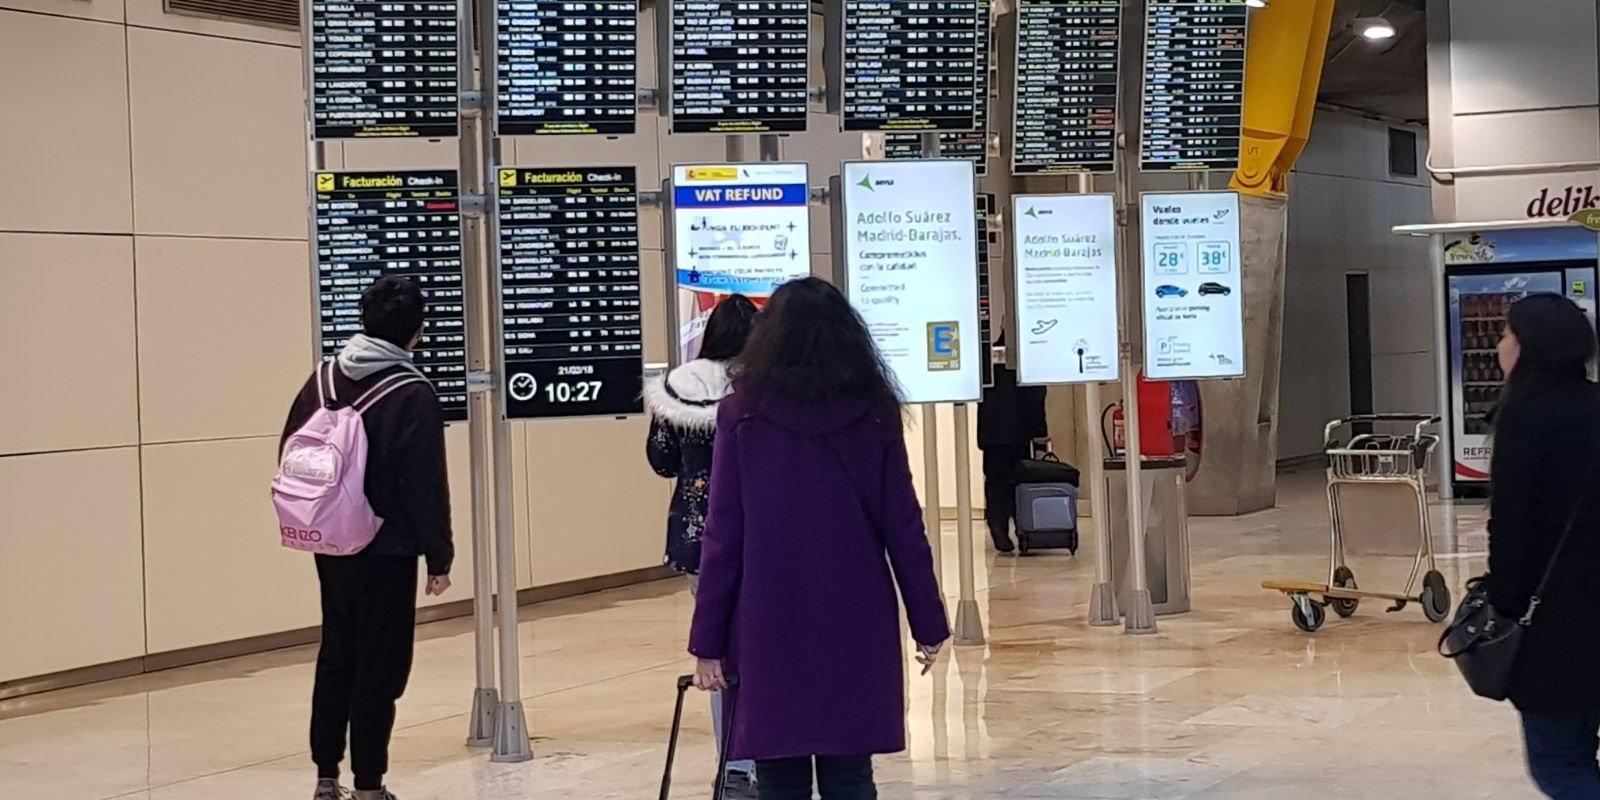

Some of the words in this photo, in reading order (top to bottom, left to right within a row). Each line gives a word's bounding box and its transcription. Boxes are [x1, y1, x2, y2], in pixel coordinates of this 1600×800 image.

[343, 176, 403, 187] Facturación
[408, 177, 444, 186] Check-in
[525, 172, 583, 184] Facturación
[587, 172, 622, 182] Check-in
[695, 189, 722, 201] VAT
[725, 188, 783, 201] REFUND
[857, 211, 902, 224] Adolfo
[905, 210, 951, 223] Suárez
[857, 229, 962, 242] Madrid-Barajas.
[934, 326, 952, 353] E
[545, 381, 602, 402] 10:27
